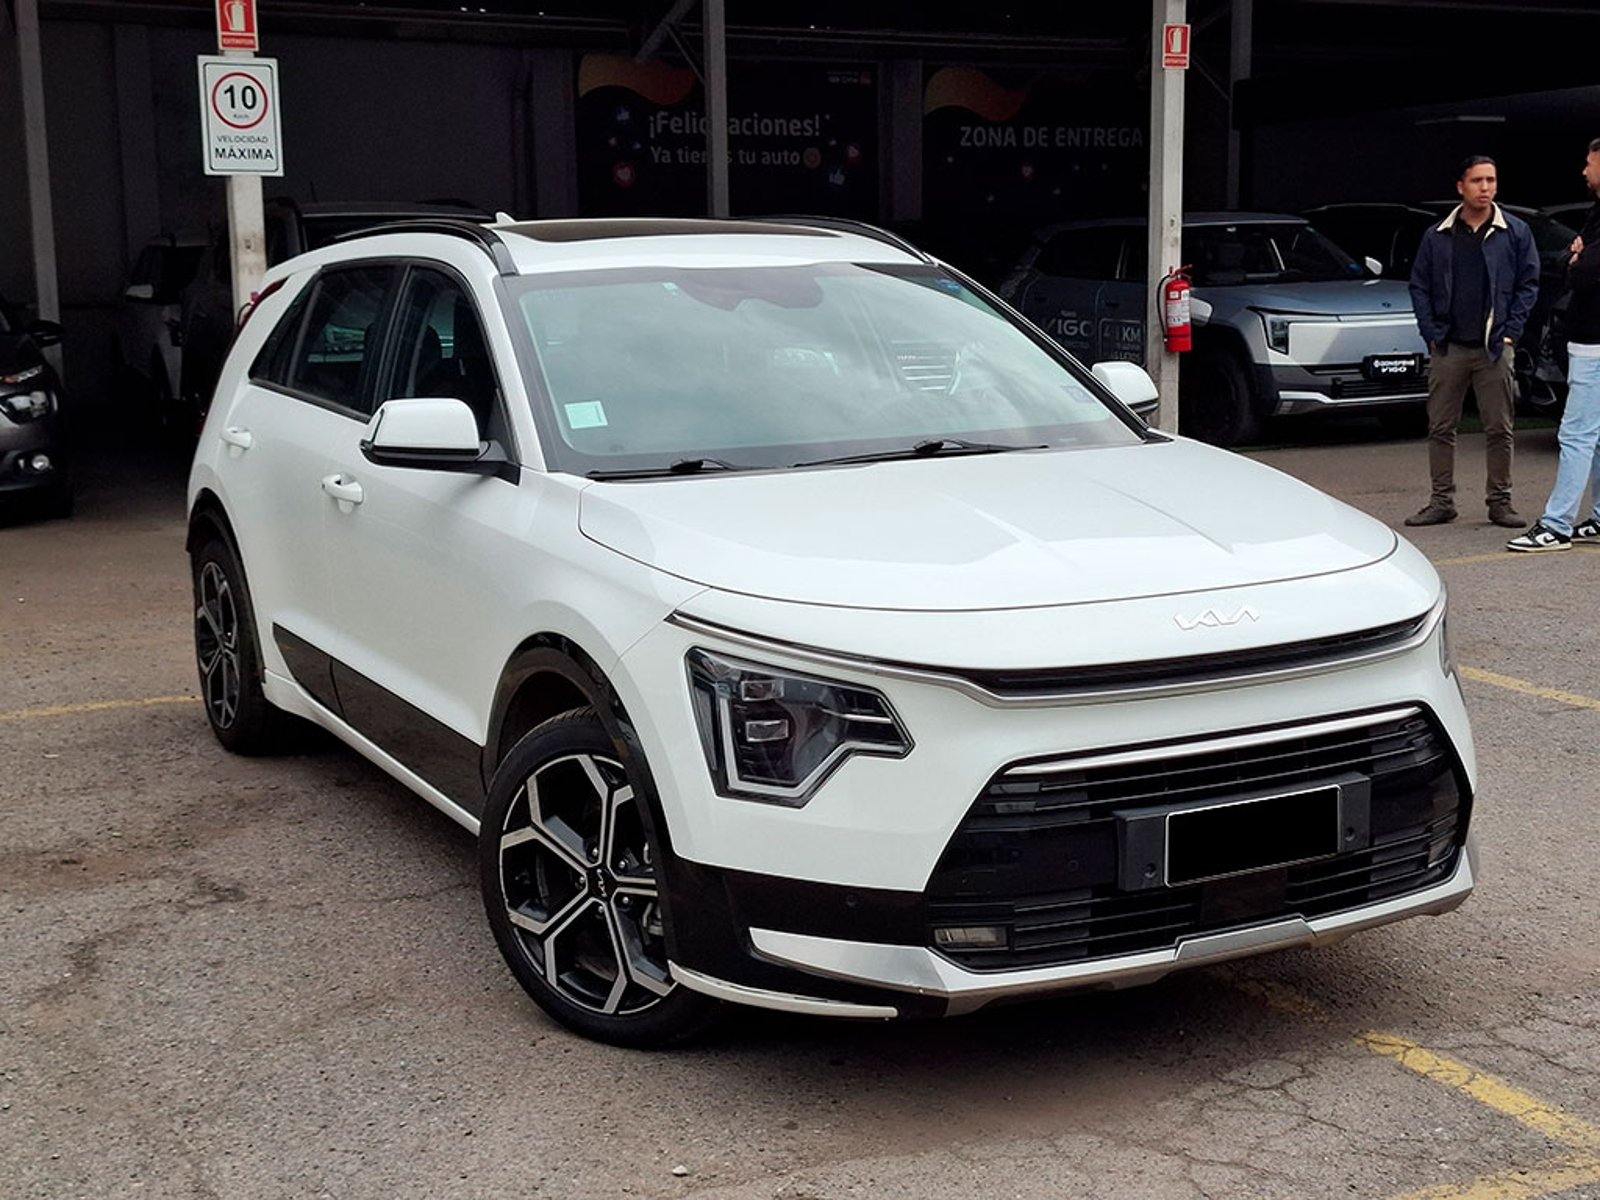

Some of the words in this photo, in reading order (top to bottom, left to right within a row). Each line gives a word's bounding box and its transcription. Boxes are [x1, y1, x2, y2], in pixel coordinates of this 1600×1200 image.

[224, 85, 256, 108] 10
[649, 110, 821, 139] ¡Felicaciones!
[216, 135, 269, 144] VELOCIDAD
[959, 126, 1017, 147] ZONA
[1023, 126, 1049, 147] DE
[1055, 127, 1144, 148] ENTREGA
[214, 147, 274, 160] MÁXIMA
[650, 146, 672, 164] Ya
[739, 149, 757, 165] tu
[761, 149, 801, 166] auto
[1173, 607, 1260, 630] KIA
